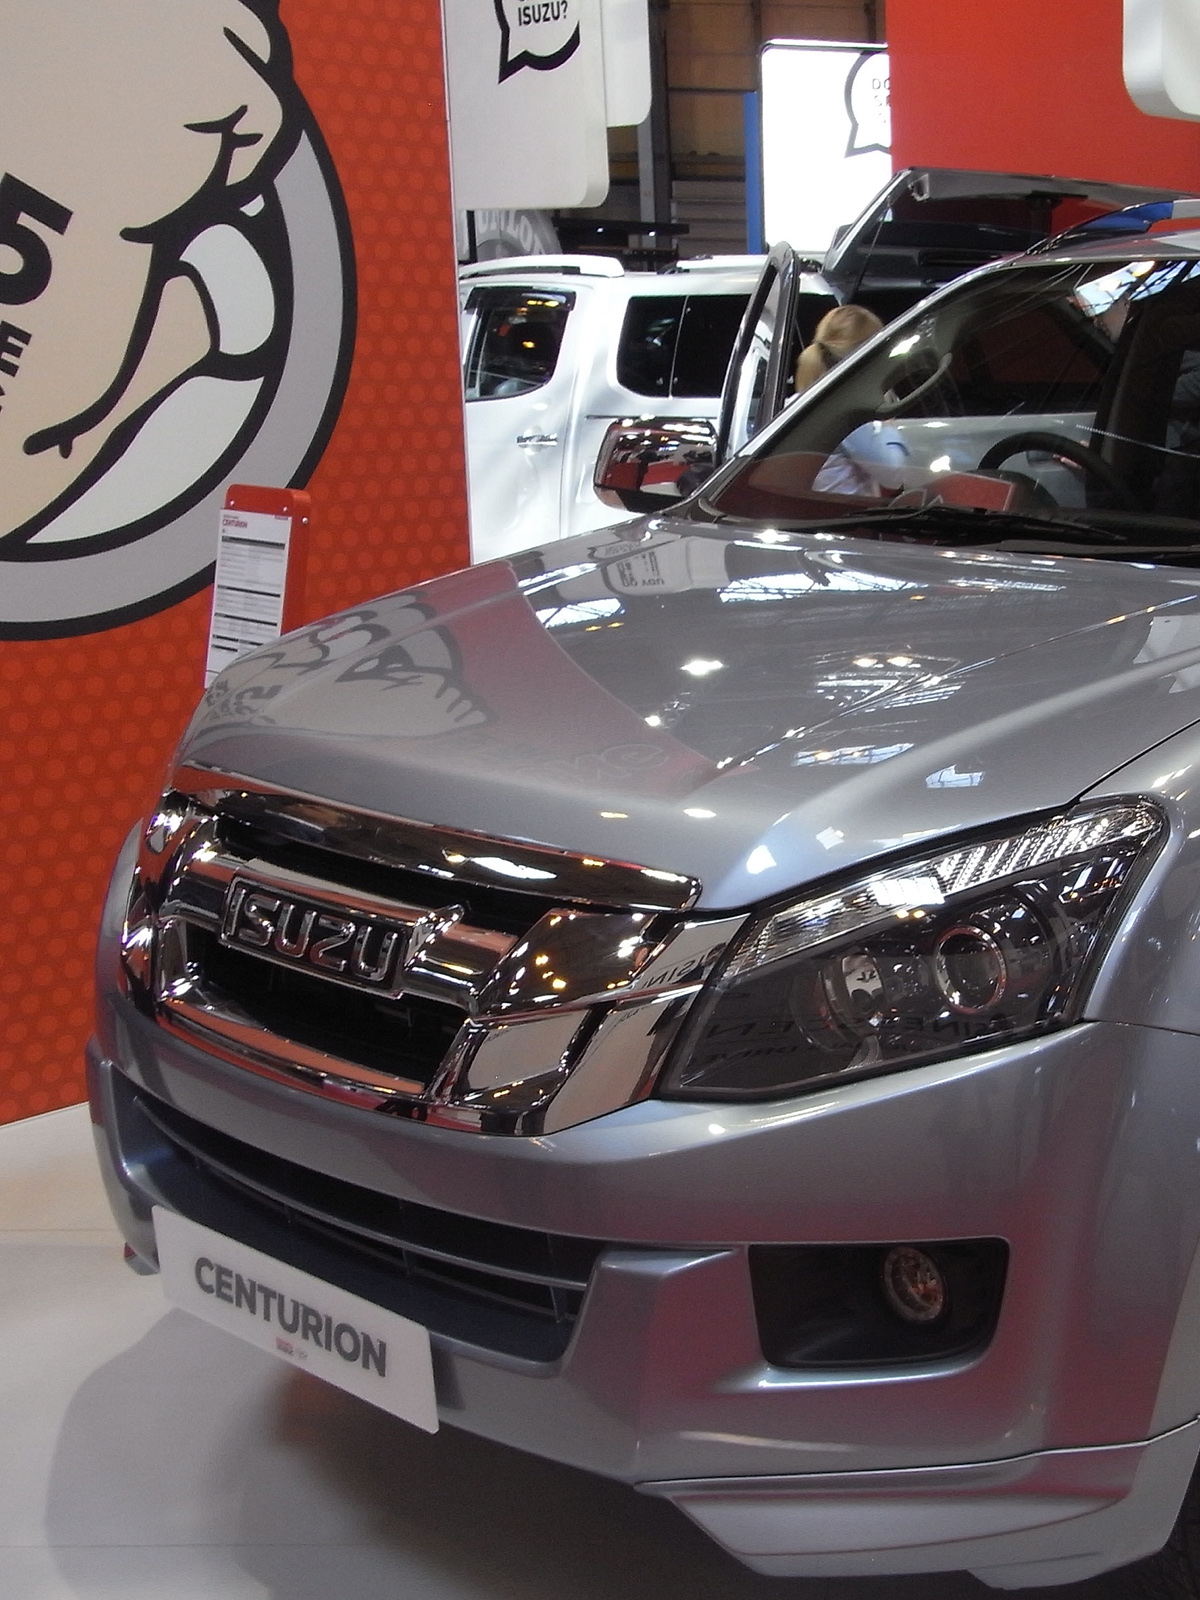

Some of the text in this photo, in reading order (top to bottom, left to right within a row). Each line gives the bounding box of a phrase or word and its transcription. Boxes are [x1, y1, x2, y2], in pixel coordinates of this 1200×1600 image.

[518, 0, 568, 26] ISUZU?
[228, 887, 399, 982] ISUZU
[195, 1257, 386, 1377] CENTURION
